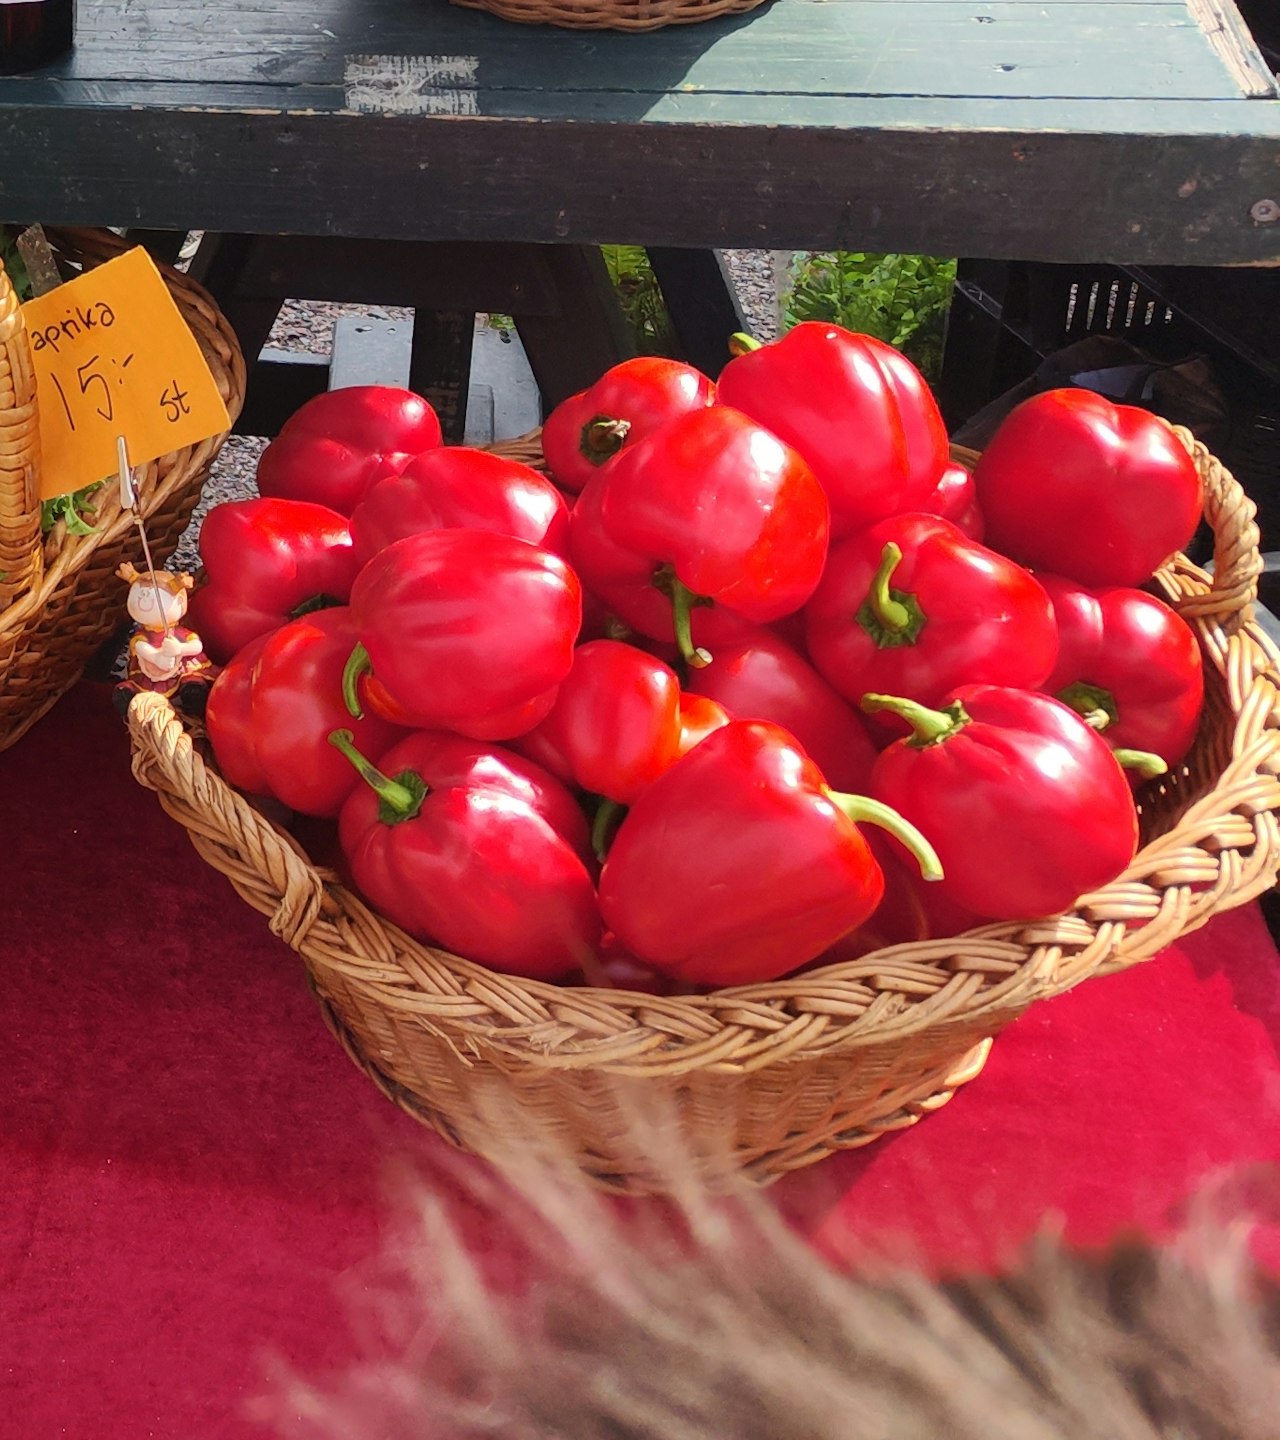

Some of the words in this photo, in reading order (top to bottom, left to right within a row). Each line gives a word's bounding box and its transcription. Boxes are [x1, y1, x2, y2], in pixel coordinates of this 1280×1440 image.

[29, 301, 116, 354] aprika
[48, 352, 135, 432] 15:-
[159, 379, 191, 424] st
